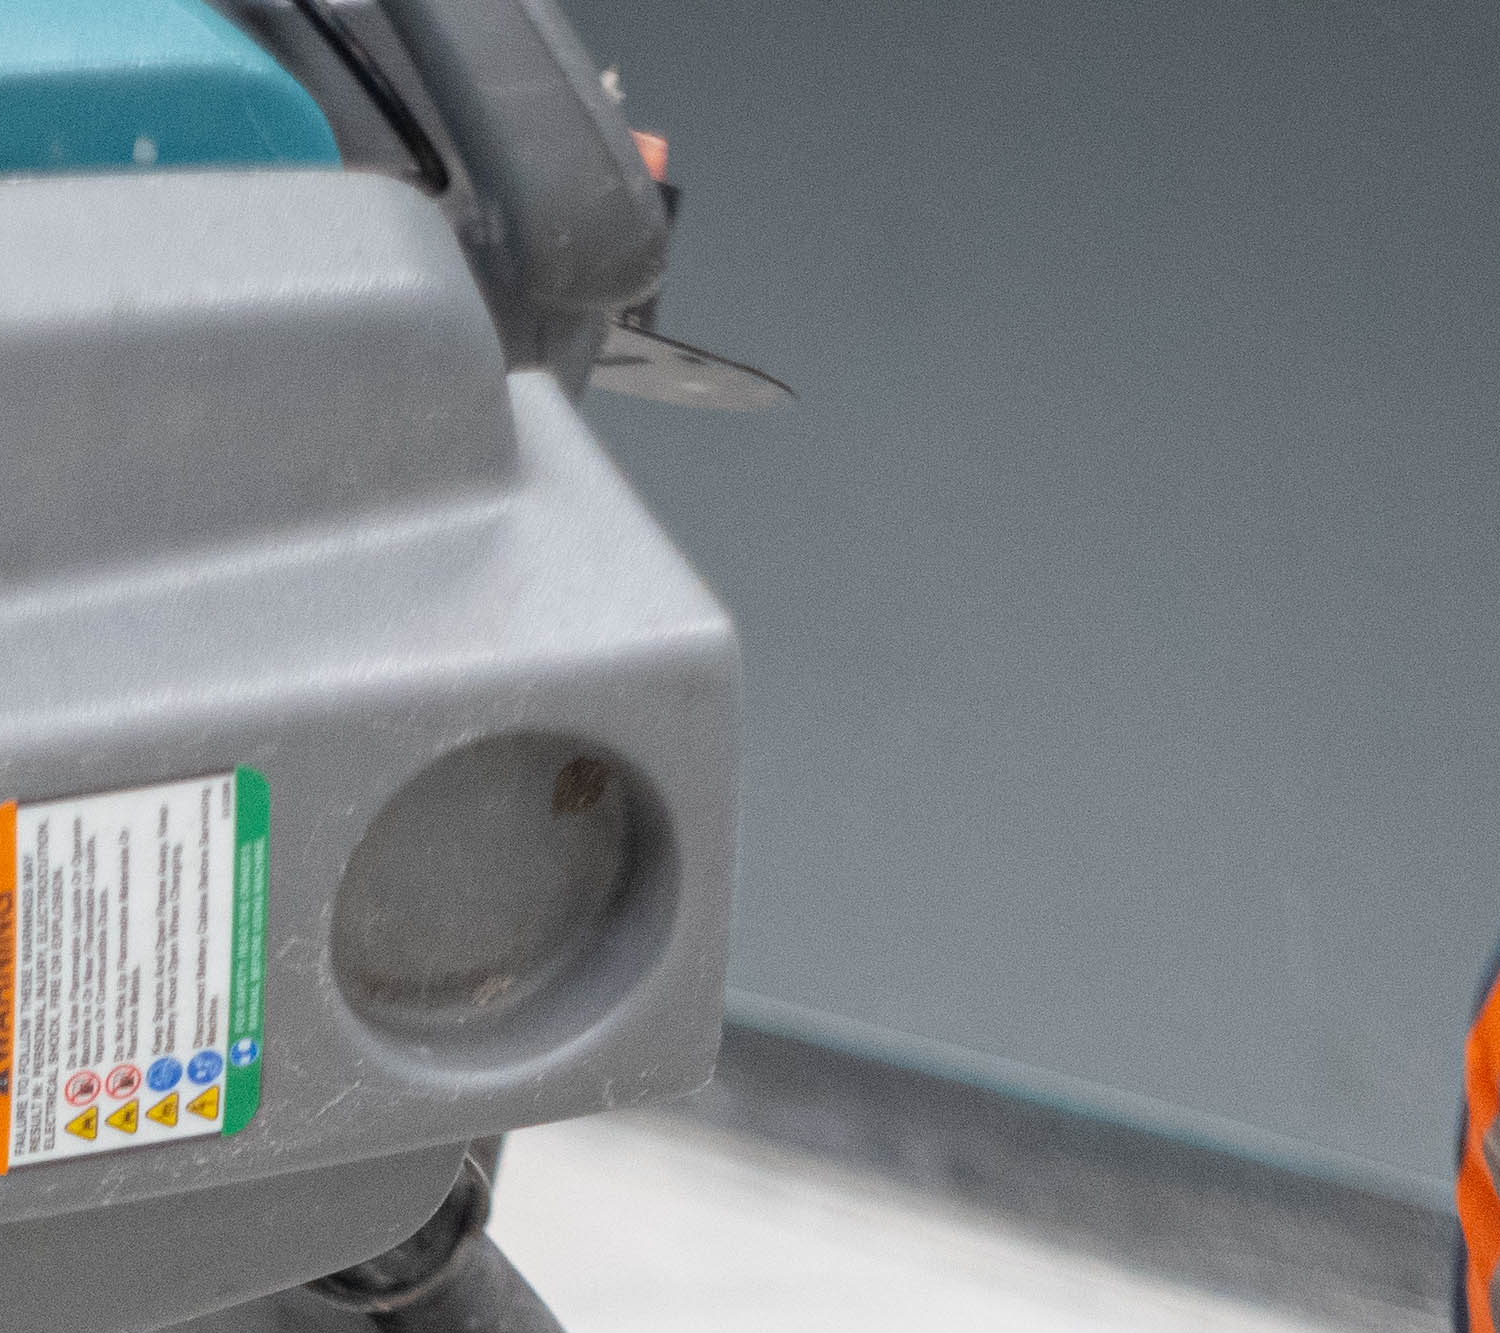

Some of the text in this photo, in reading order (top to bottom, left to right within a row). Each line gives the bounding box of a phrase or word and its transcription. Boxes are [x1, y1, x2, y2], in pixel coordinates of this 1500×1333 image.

[21, 886, 34, 965] WARNINGS
[19, 968, 32, 1013] THESE
[49, 953, 61, 975] OR
[48, 978, 61, 1009] FIRE
[18, 1018, 30, 1074] FOLLOW
[32, 1002, 46, 1078] PERSONAL
[17, 1077, 29, 1096] TO
[44, 1067, 57, 1150] ELECTRICAL
[16, 1100, 28, 1155] FAILURE
[29, 1101, 42, 1153] RESULT
